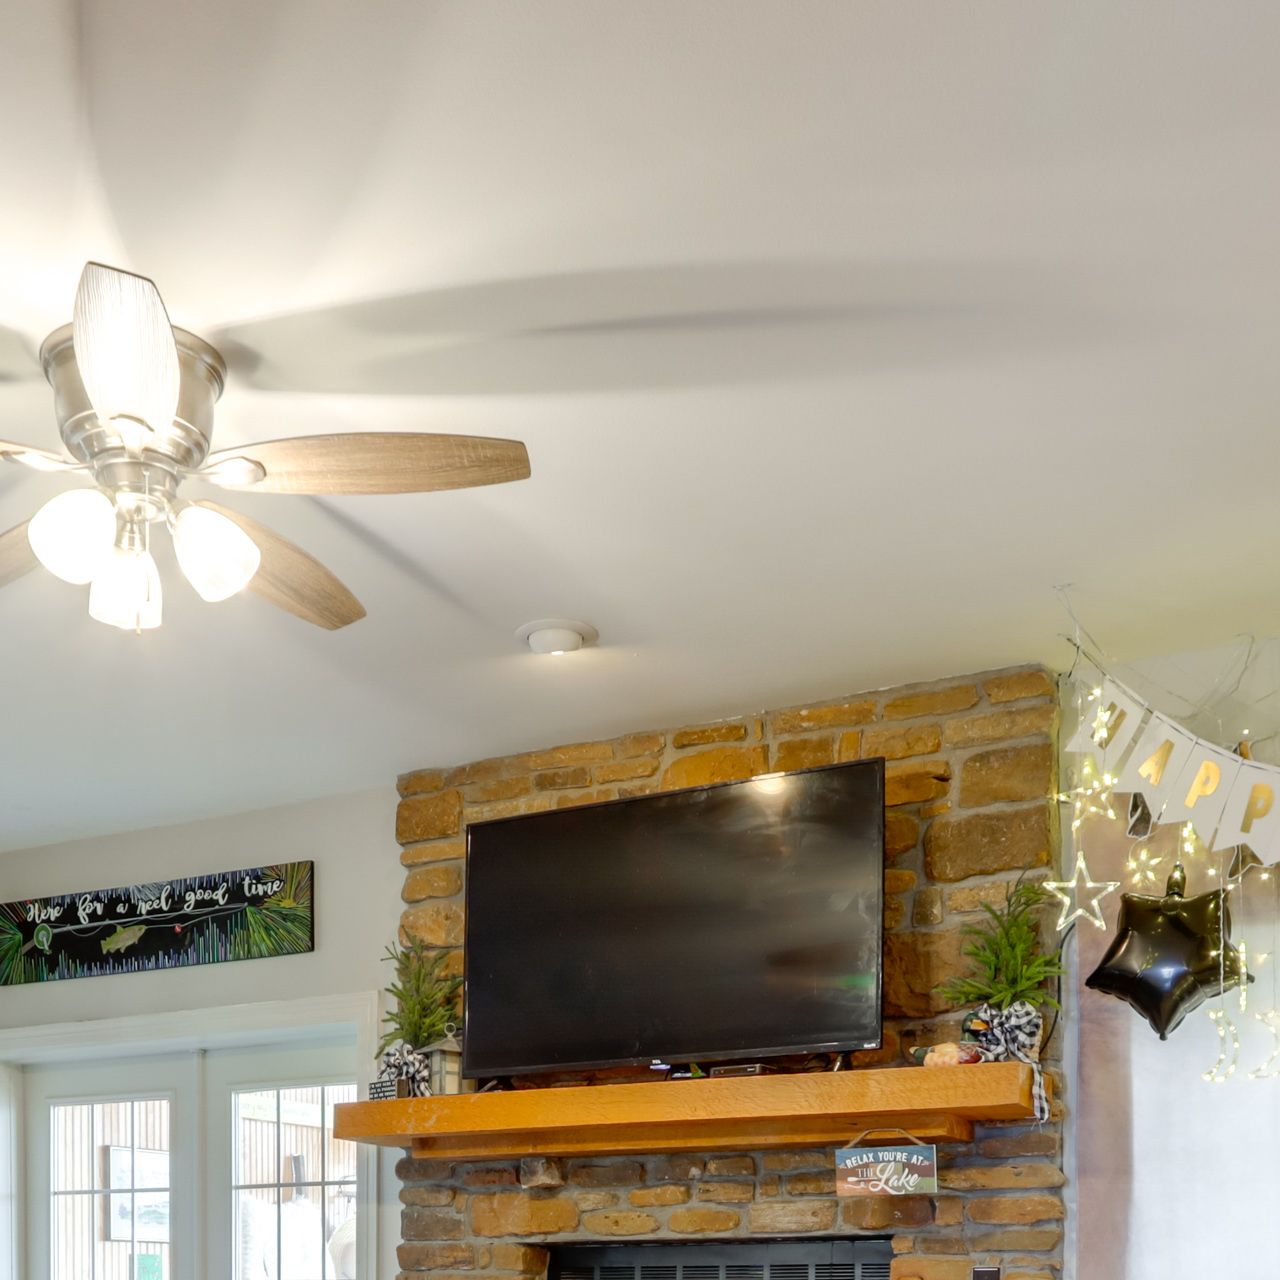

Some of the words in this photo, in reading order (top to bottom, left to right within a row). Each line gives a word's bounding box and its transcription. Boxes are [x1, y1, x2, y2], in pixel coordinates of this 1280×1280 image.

[26, 902, 64, 923] Here
[76, 894, 105, 925] for
[115, 902, 129, 915] a
[136, 885, 172, 914] reel
[183, 882, 229, 911] good
[241, 875, 285, 897] time
[845, 1151, 875, 1169] RELAX
[877, 1151, 909, 1162] YOU'RE
[910, 1154, 925, 1166] AT
[868, 1161, 921, 1195] Lake
